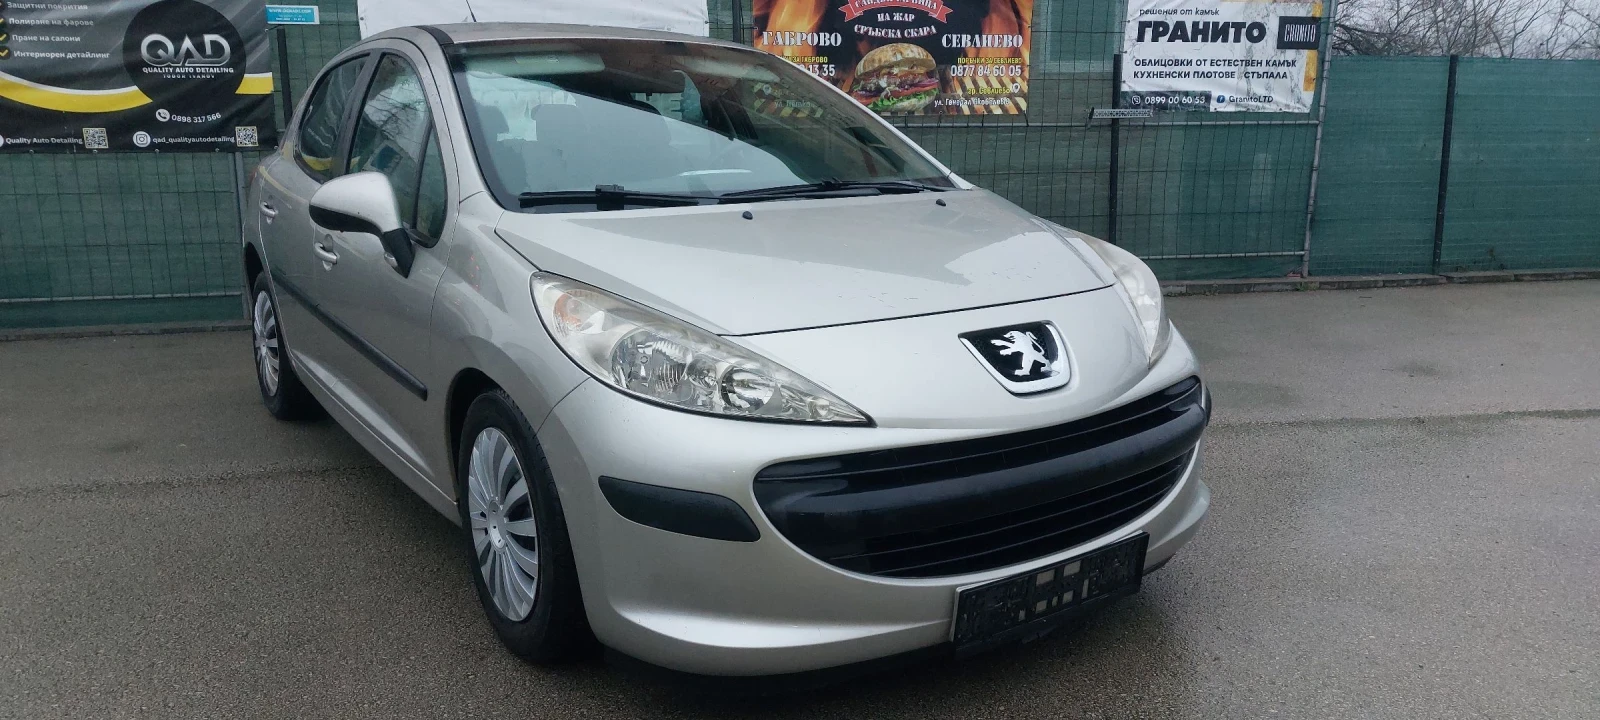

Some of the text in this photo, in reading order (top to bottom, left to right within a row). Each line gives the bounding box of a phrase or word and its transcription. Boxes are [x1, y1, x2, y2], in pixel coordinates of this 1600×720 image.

[7, 2, 46, 10] Защитни
[1195, 7, 1219, 15] камък
[877, 13, 914, 22] НА ЖАР
[63, 19, 94, 27] фарове
[854, 24, 937, 38] СРЪБСКА СКАРА
[1137, 21, 1266, 43] ГРАНИТО
[12, 34, 37, 42] Пране
[762, 31, 842, 46] ГАБРОВО
[141, 33, 230, 66] QAD
[14, 51, 110, 59] Интериорен детайлинг
[1134, 59, 1192, 67] ОБЛИЦОВКИ
[1195, 59, 1207, 67] ОТ
[1210, 59, 1262, 67] ЕСТЕСТВЕН
[822, 64, 835, 77] 35
[951, 65, 1021, 77] 0877 84 60 05
[1193, 71, 1235, 79] ПЛОТОВЕ
[1244, 71, 1288, 79] СТЪПАЛА
[945, 98, 971, 107] Генерал
[1144, 96, 1205, 104] 0899 00 60 53
[1229, 95, 1274, 103] GranitoLTD
[171, 114, 192, 123] 0898
[207, 112, 221, 122] 566
[152, 136, 235, 144] qad_qualityautodetailing
